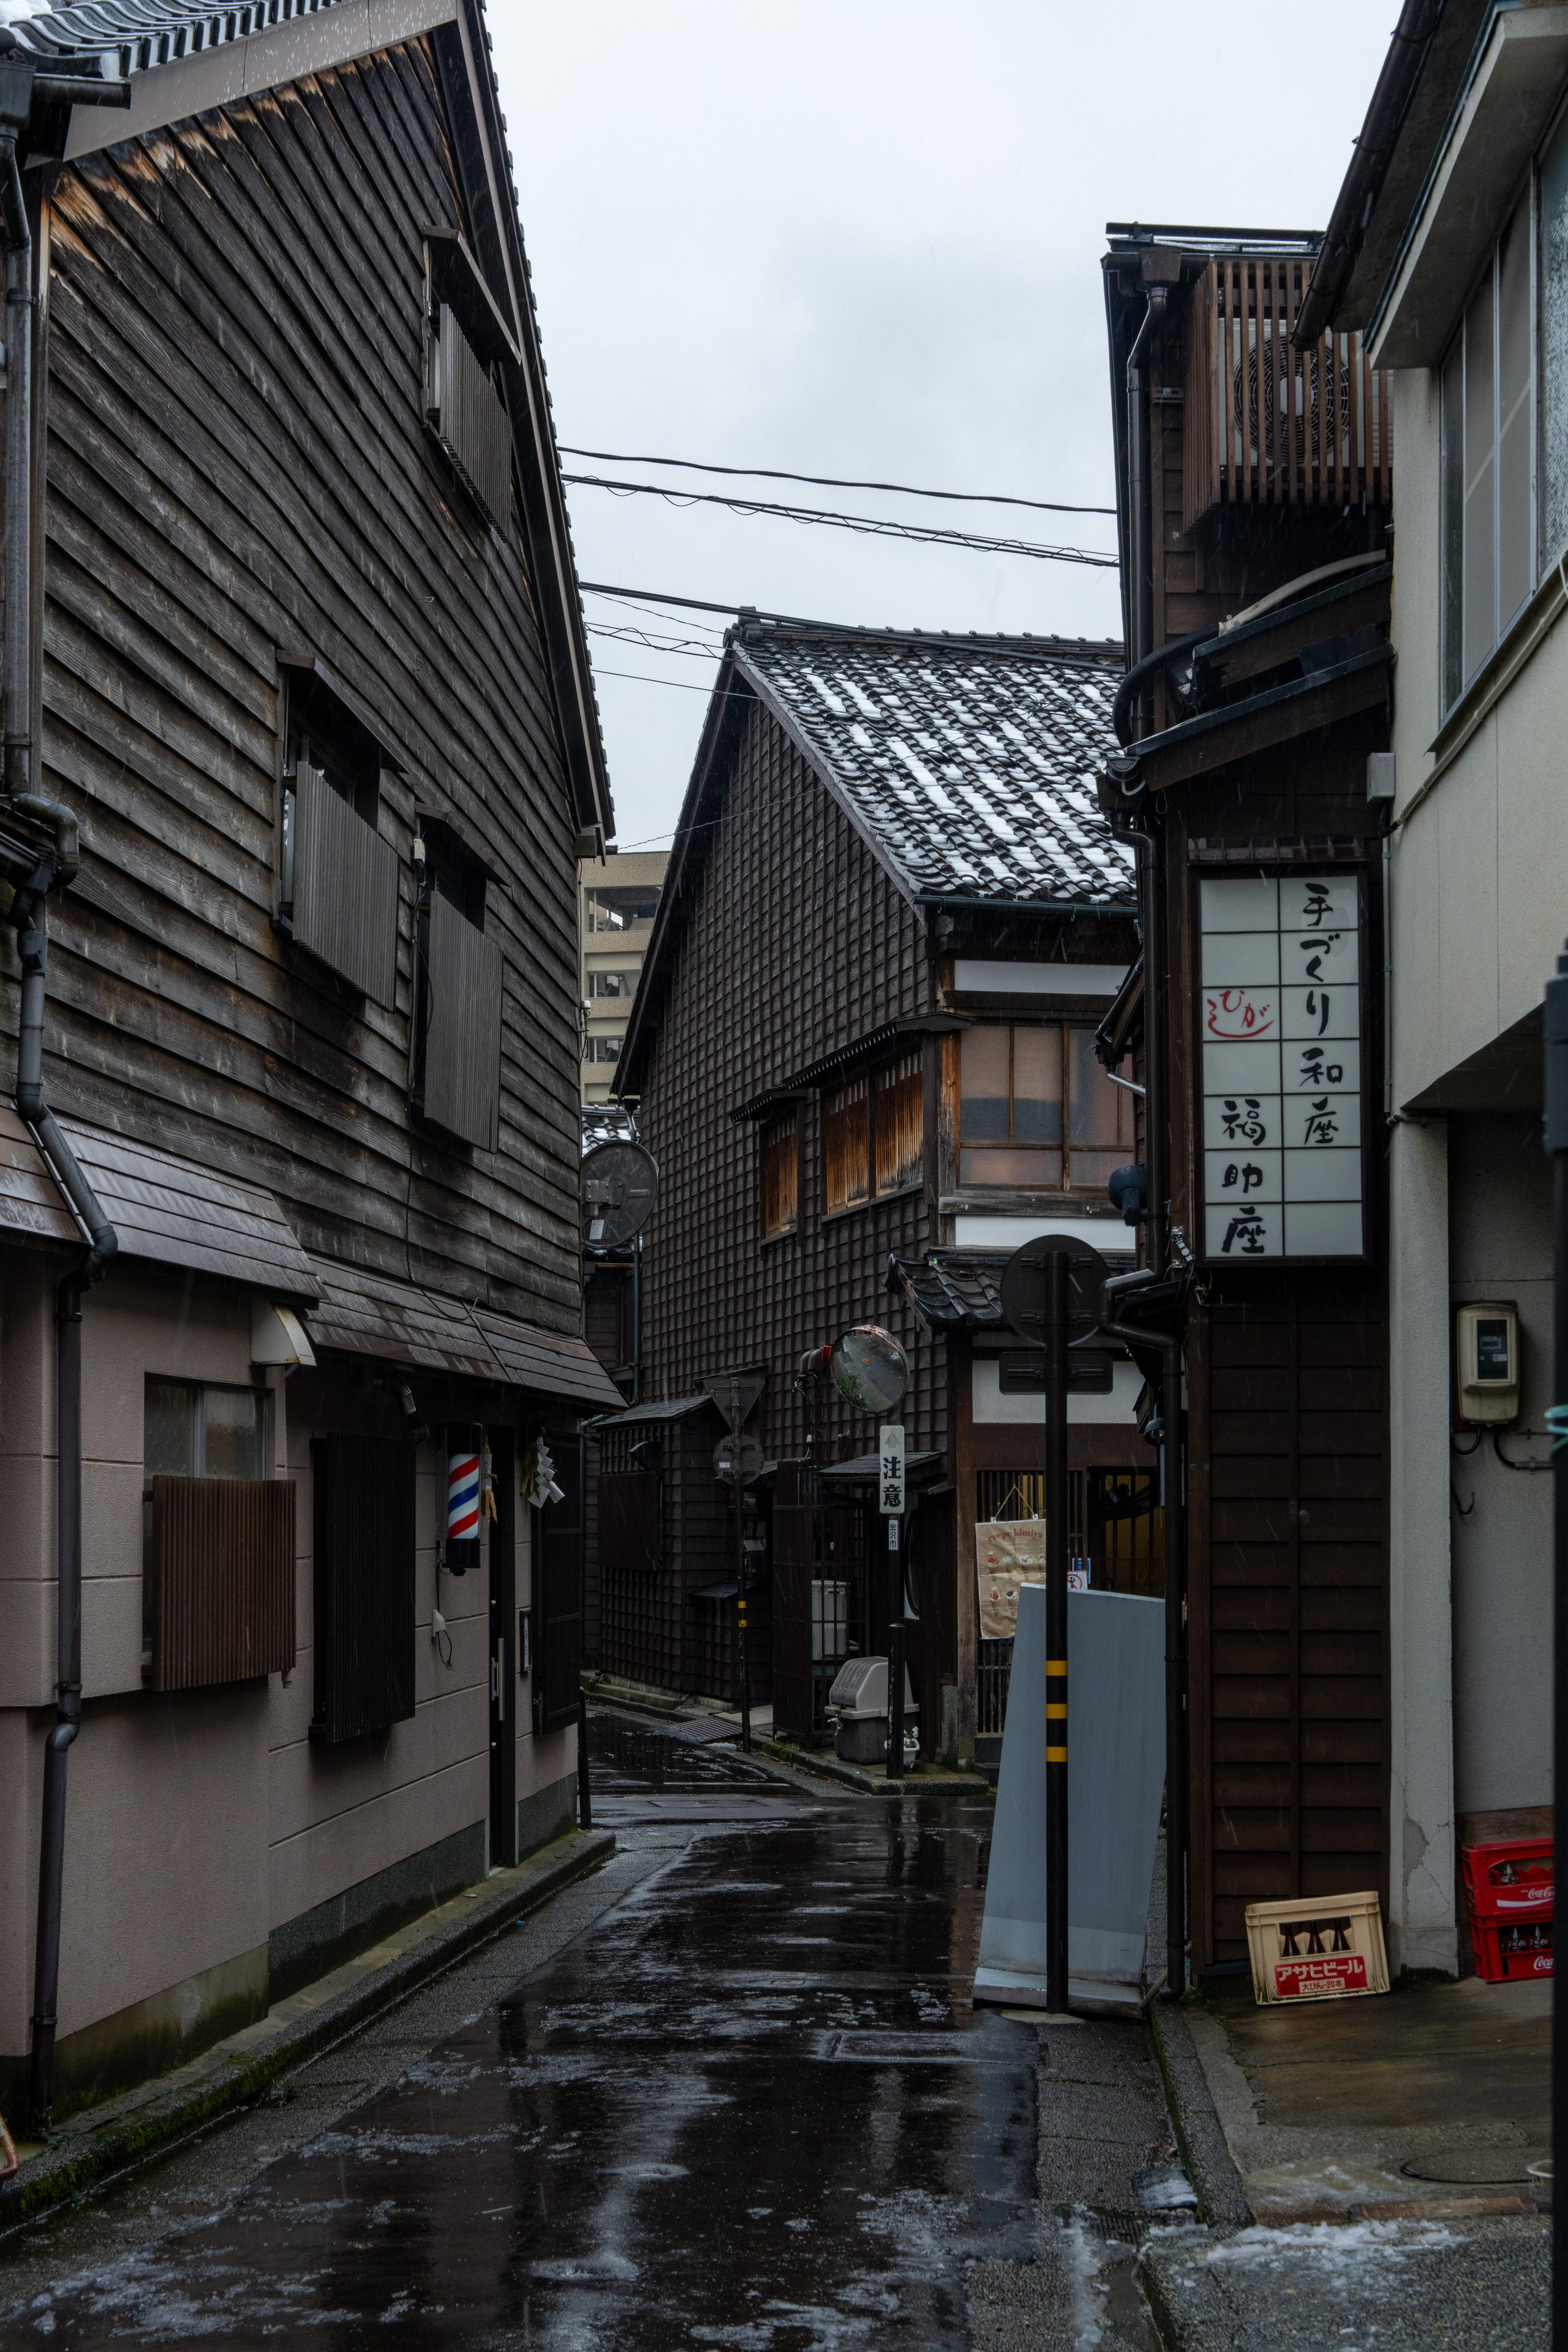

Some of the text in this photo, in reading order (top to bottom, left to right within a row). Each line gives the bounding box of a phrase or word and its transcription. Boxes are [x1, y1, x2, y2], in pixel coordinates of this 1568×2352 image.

[1299, 881, 1343, 1145] 手づくり和座
[1221, 1098, 1267, 1254] 福助座
[883, 1456, 902, 1507] 注意
[988, 1528, 1043, 1542] crepe kimiya
[1276, 1959, 1363, 1982] アサヒビール
